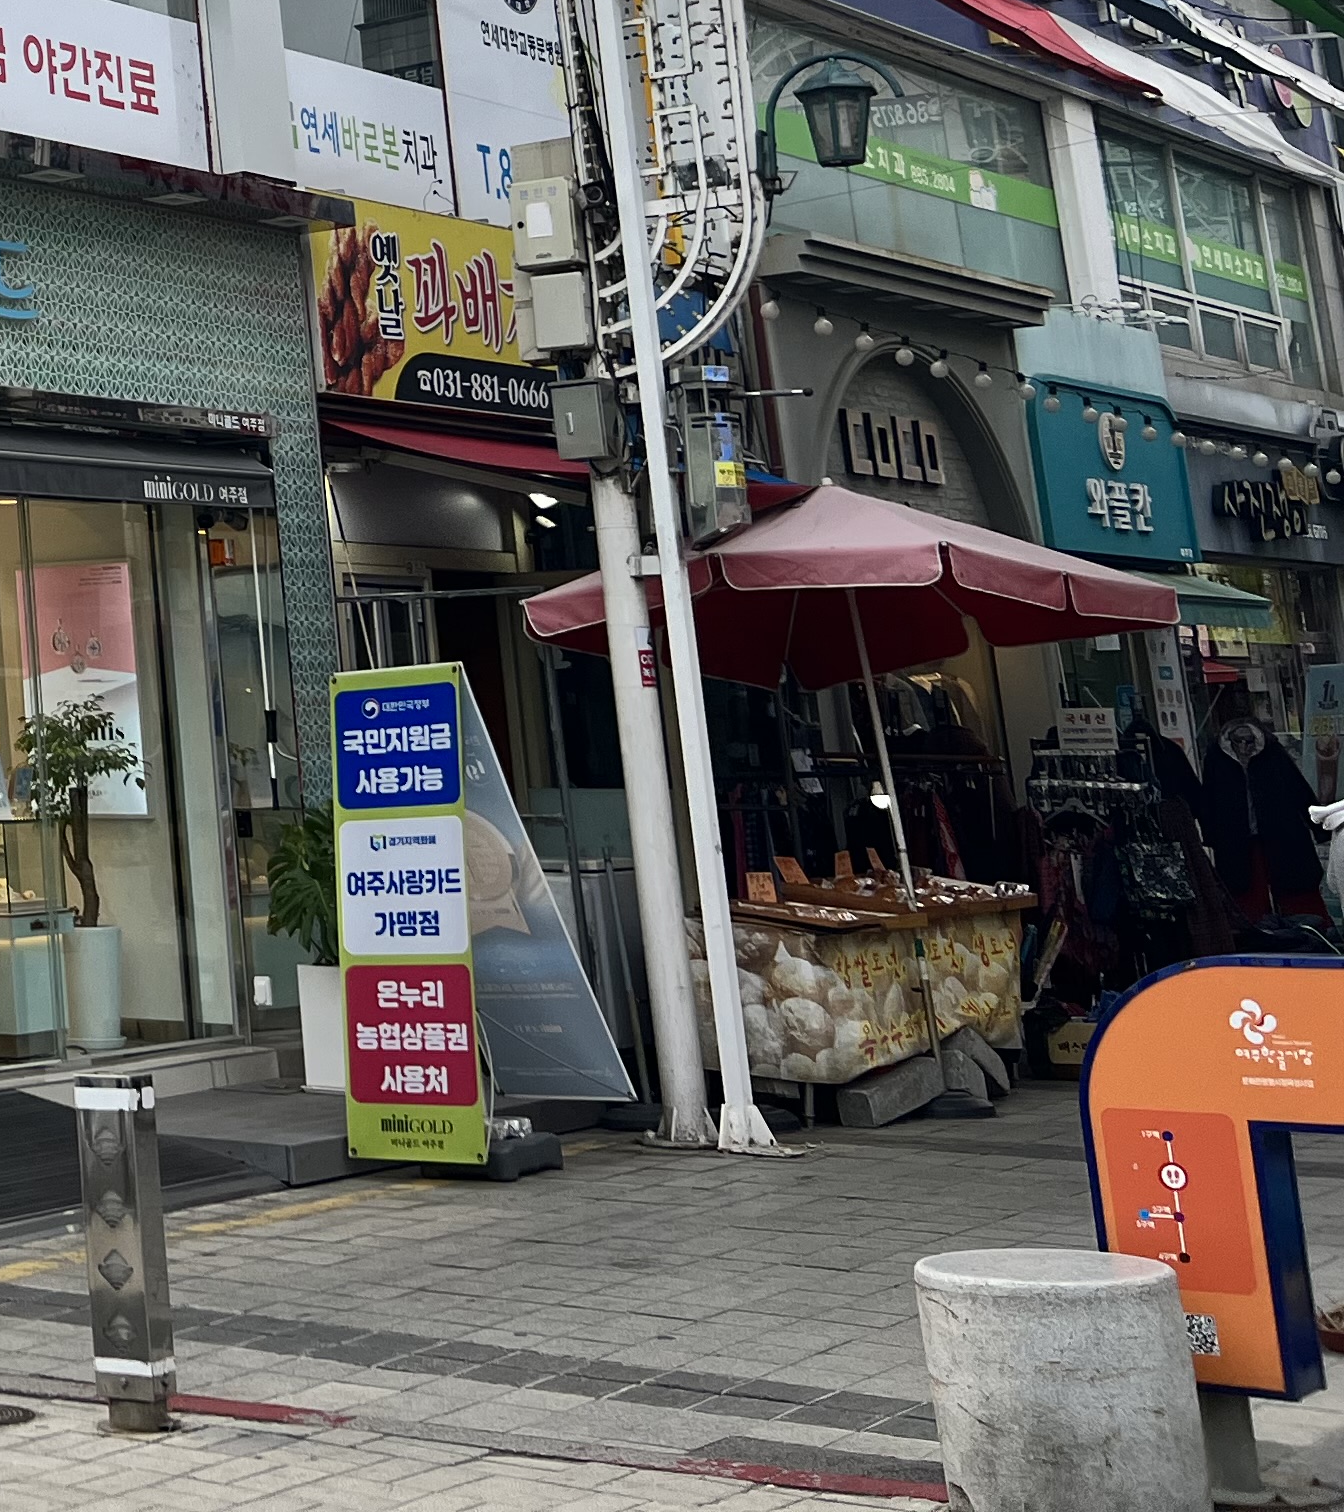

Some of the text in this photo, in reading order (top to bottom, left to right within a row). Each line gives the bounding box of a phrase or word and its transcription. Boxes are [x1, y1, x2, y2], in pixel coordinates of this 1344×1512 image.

[22, 33, 159, 115] 야간진료
[300, 106, 437, 179] 연세바로본치과
[372, 231, 405, 340] 옛날
[433, 368, 549, 409] 031-881-0666
[144, 475, 248, 504] miniGOLD 여주점
[1086, 477, 1154, 533] 와플칸
[343, 723, 451, 755] 국민지원금
[356, 765, 443, 794] 사용가능
[347, 868, 461, 896] 여주사랑카드
[375, 910, 440, 936] 가맹점
[377, 980, 444, 1009] 온누리
[356, 1022, 469, 1052] 농협상품권
[380, 1066, 448, 1095] 사용처
[380, 1114, 453, 1134] miniGOLD
